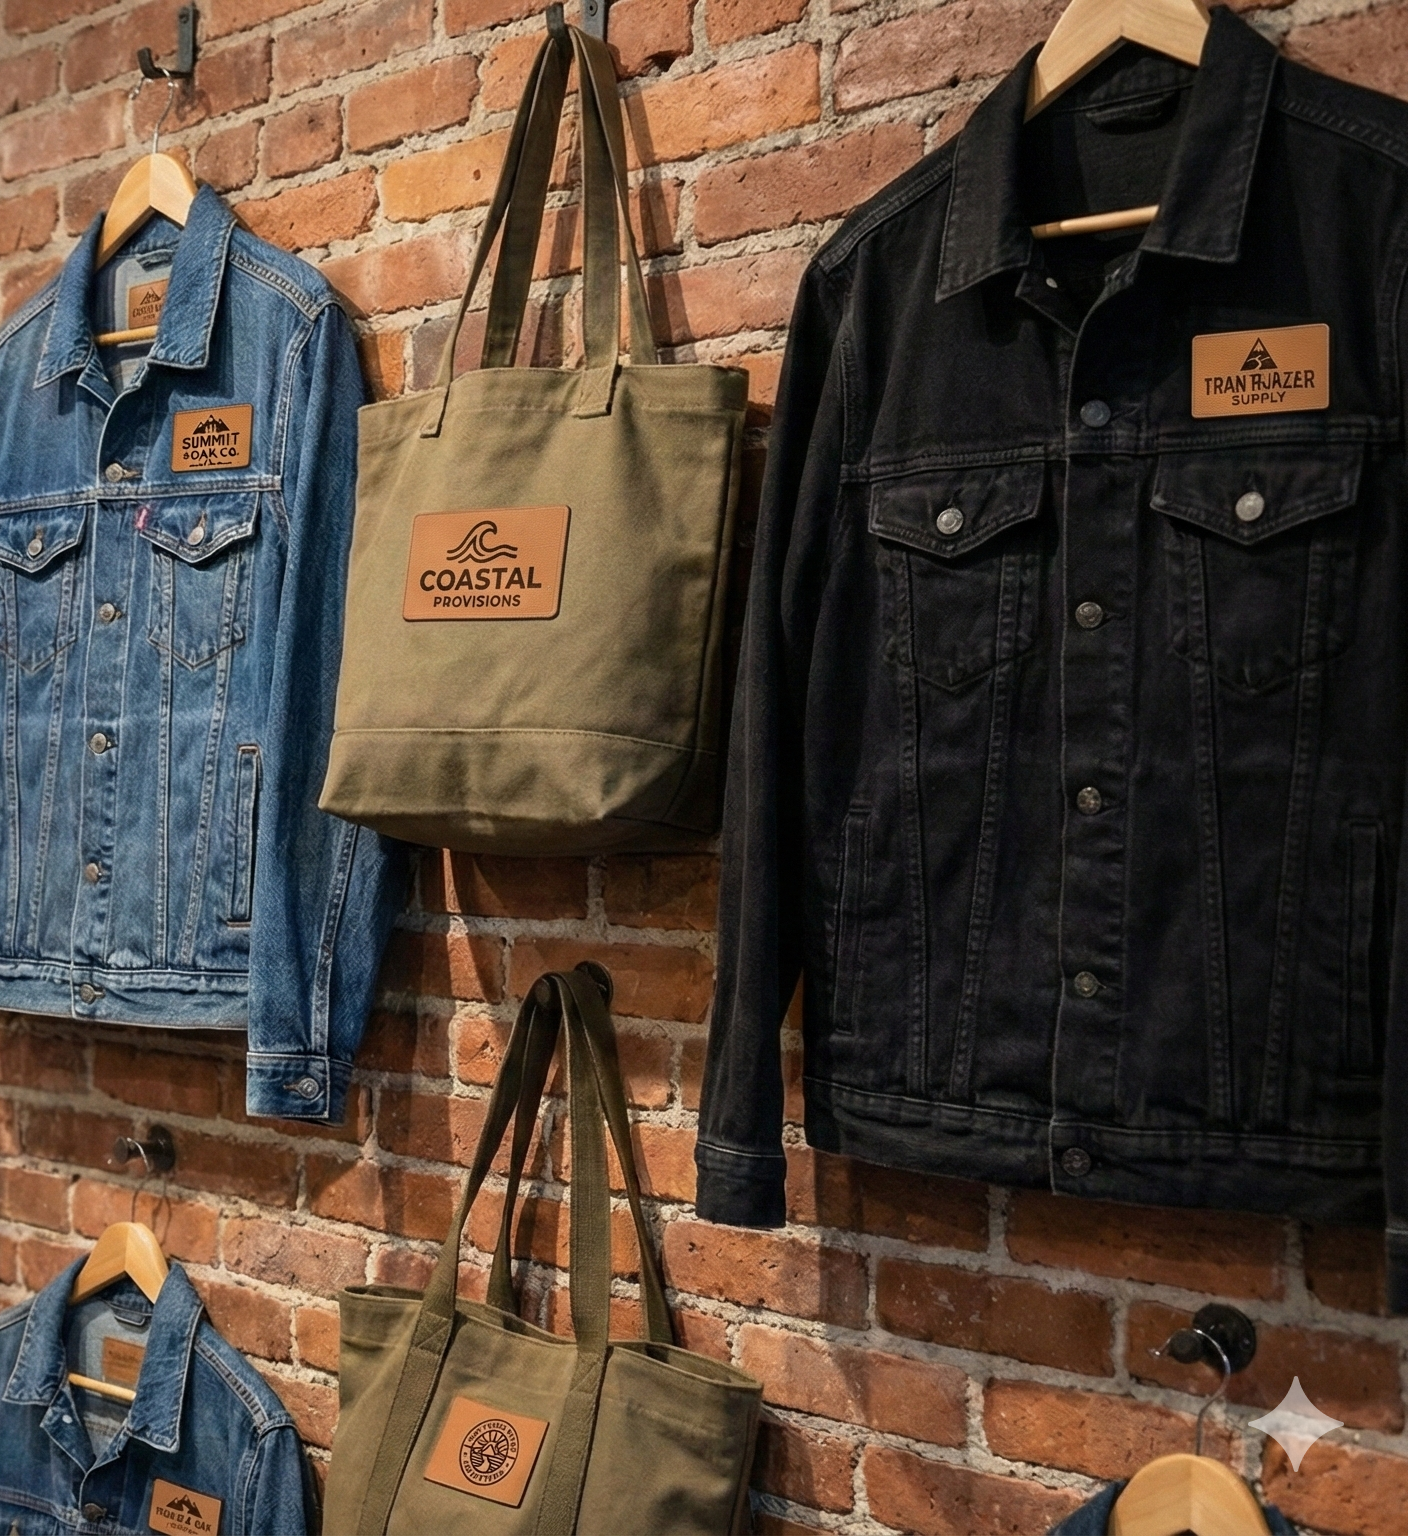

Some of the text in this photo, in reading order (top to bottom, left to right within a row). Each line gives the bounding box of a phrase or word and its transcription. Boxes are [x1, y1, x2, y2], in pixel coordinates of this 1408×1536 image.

[1232, 391, 1286, 406] SUPPLY
[182, 432, 240, 449] SUMMIT
[220, 447, 240, 457] CO.
[419, 566, 542, 592] COASTAL
[433, 595, 521, 608] PROVISIONS
